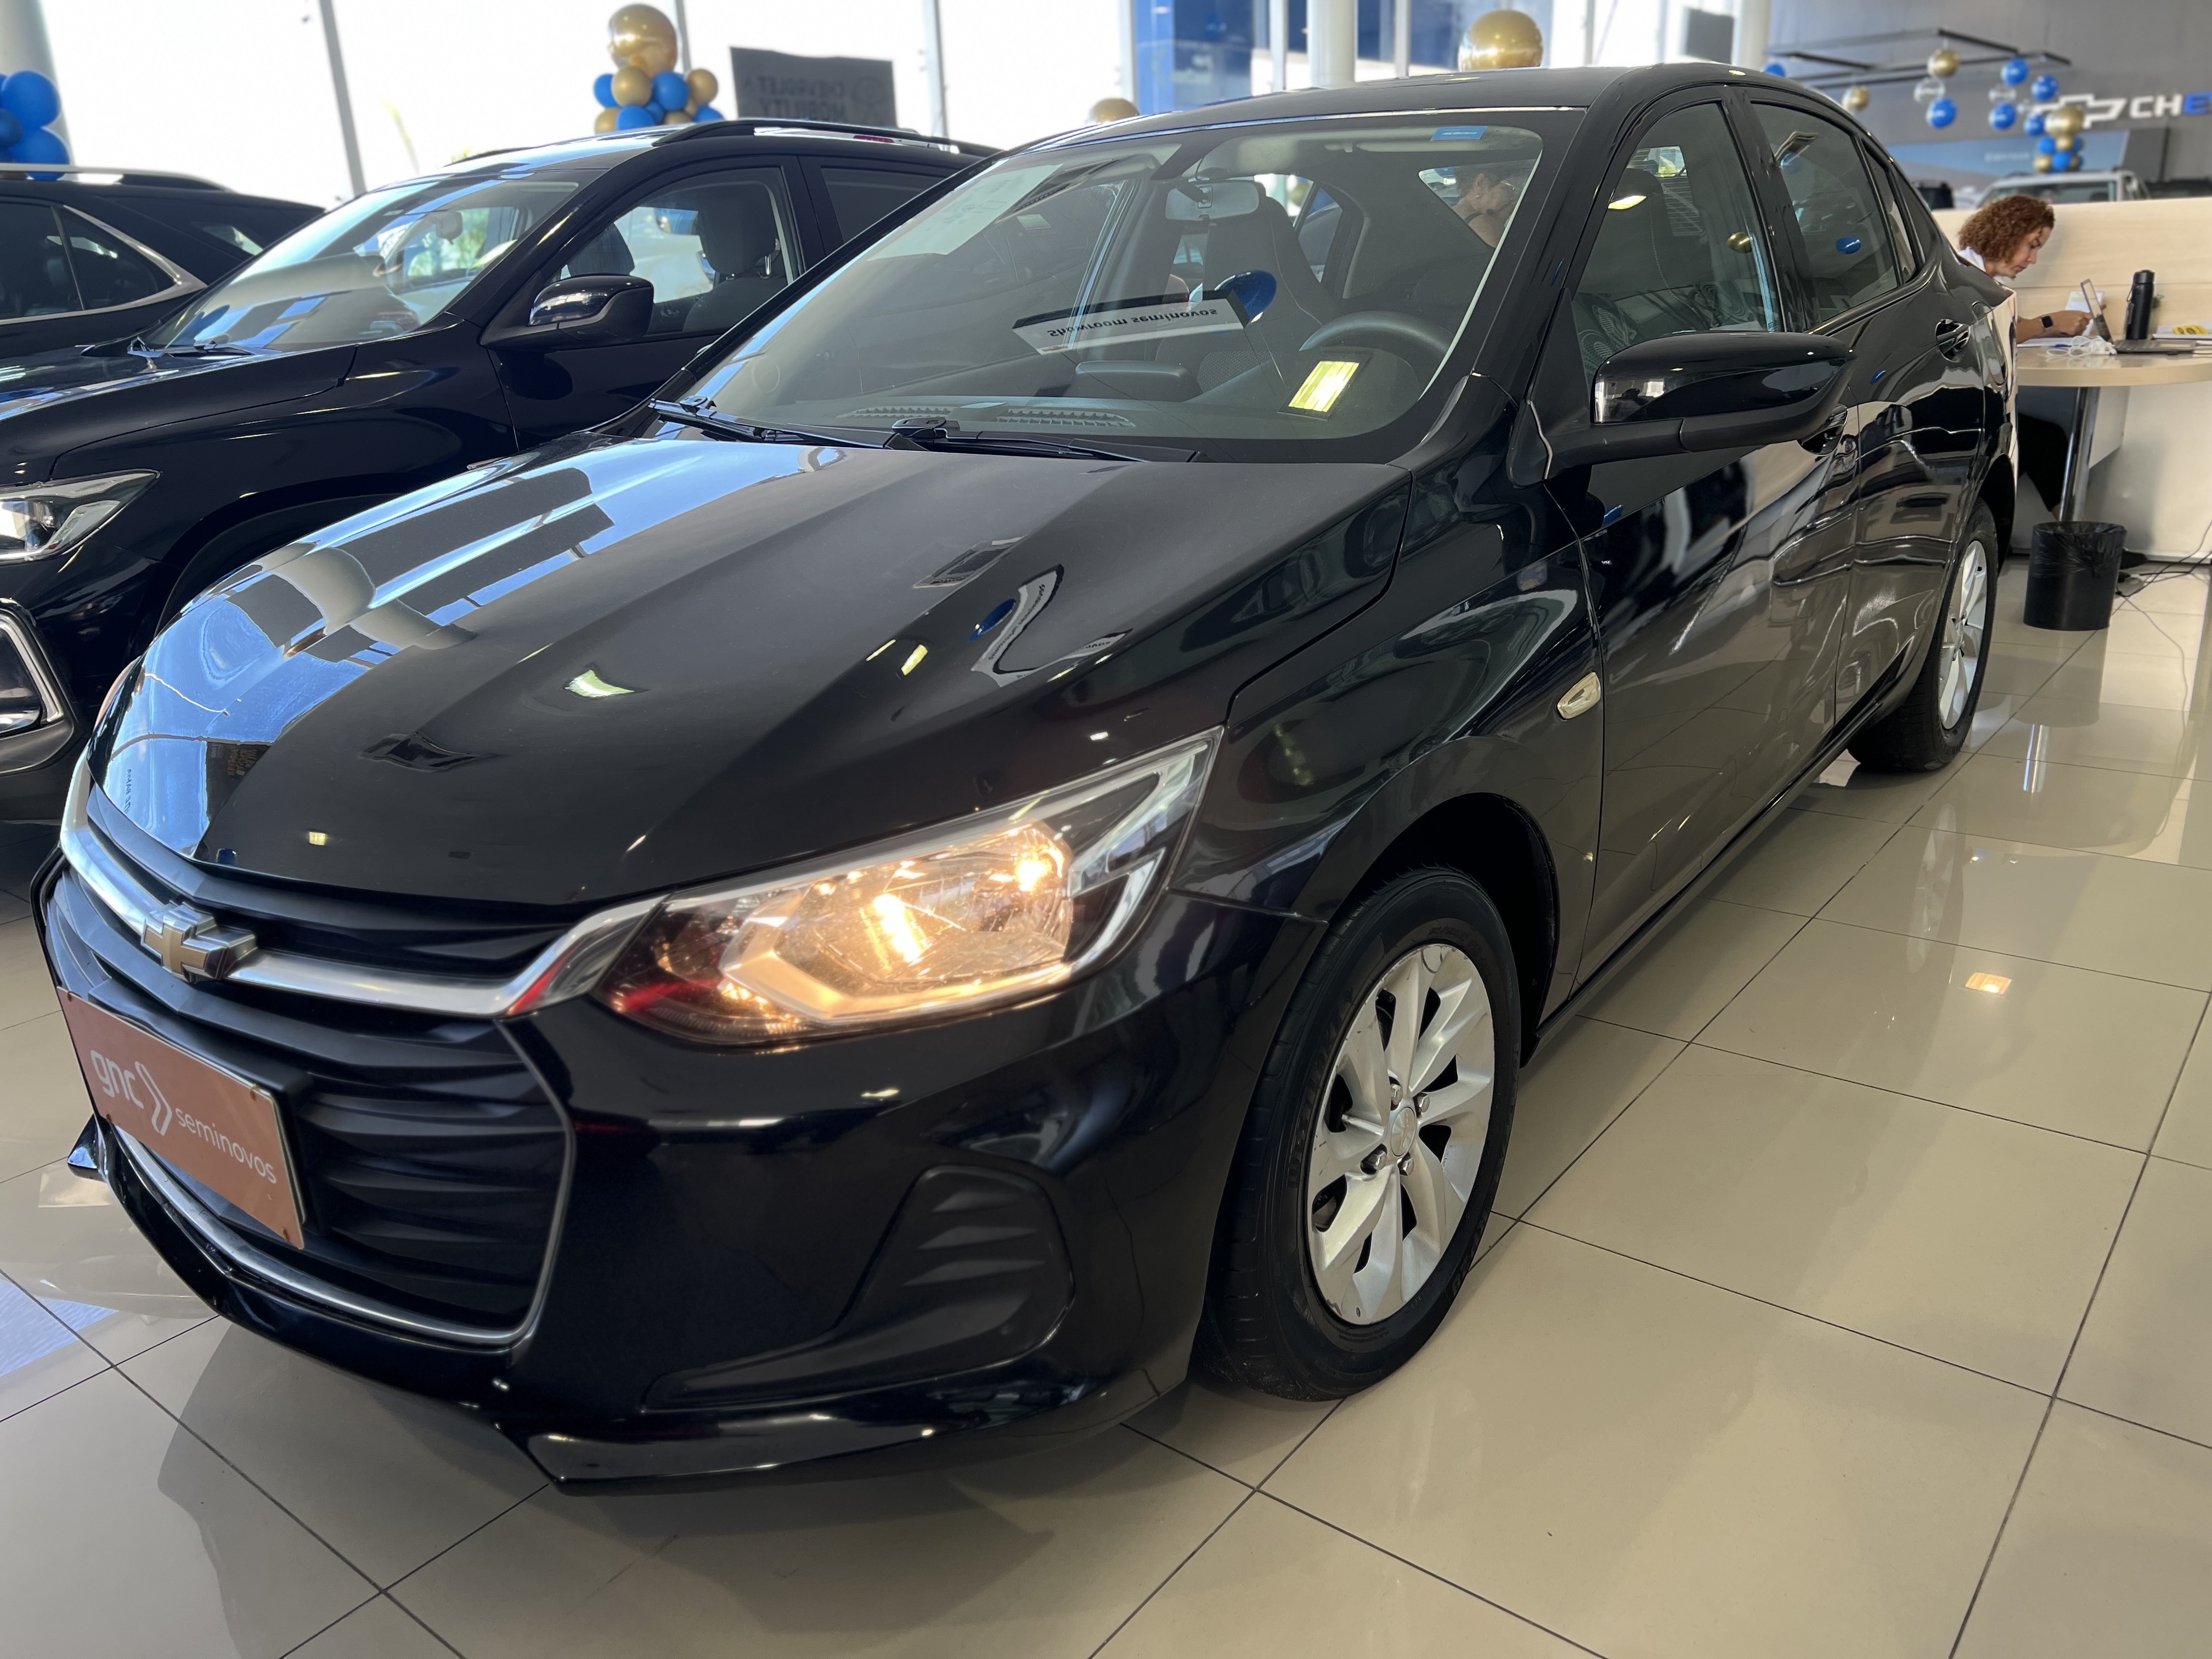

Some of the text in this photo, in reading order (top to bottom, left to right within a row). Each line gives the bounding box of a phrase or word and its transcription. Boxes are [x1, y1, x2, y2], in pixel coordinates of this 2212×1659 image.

[2130, 92, 2212, 119] CHE
[90, 1049, 276, 1184] gnc seminovos
